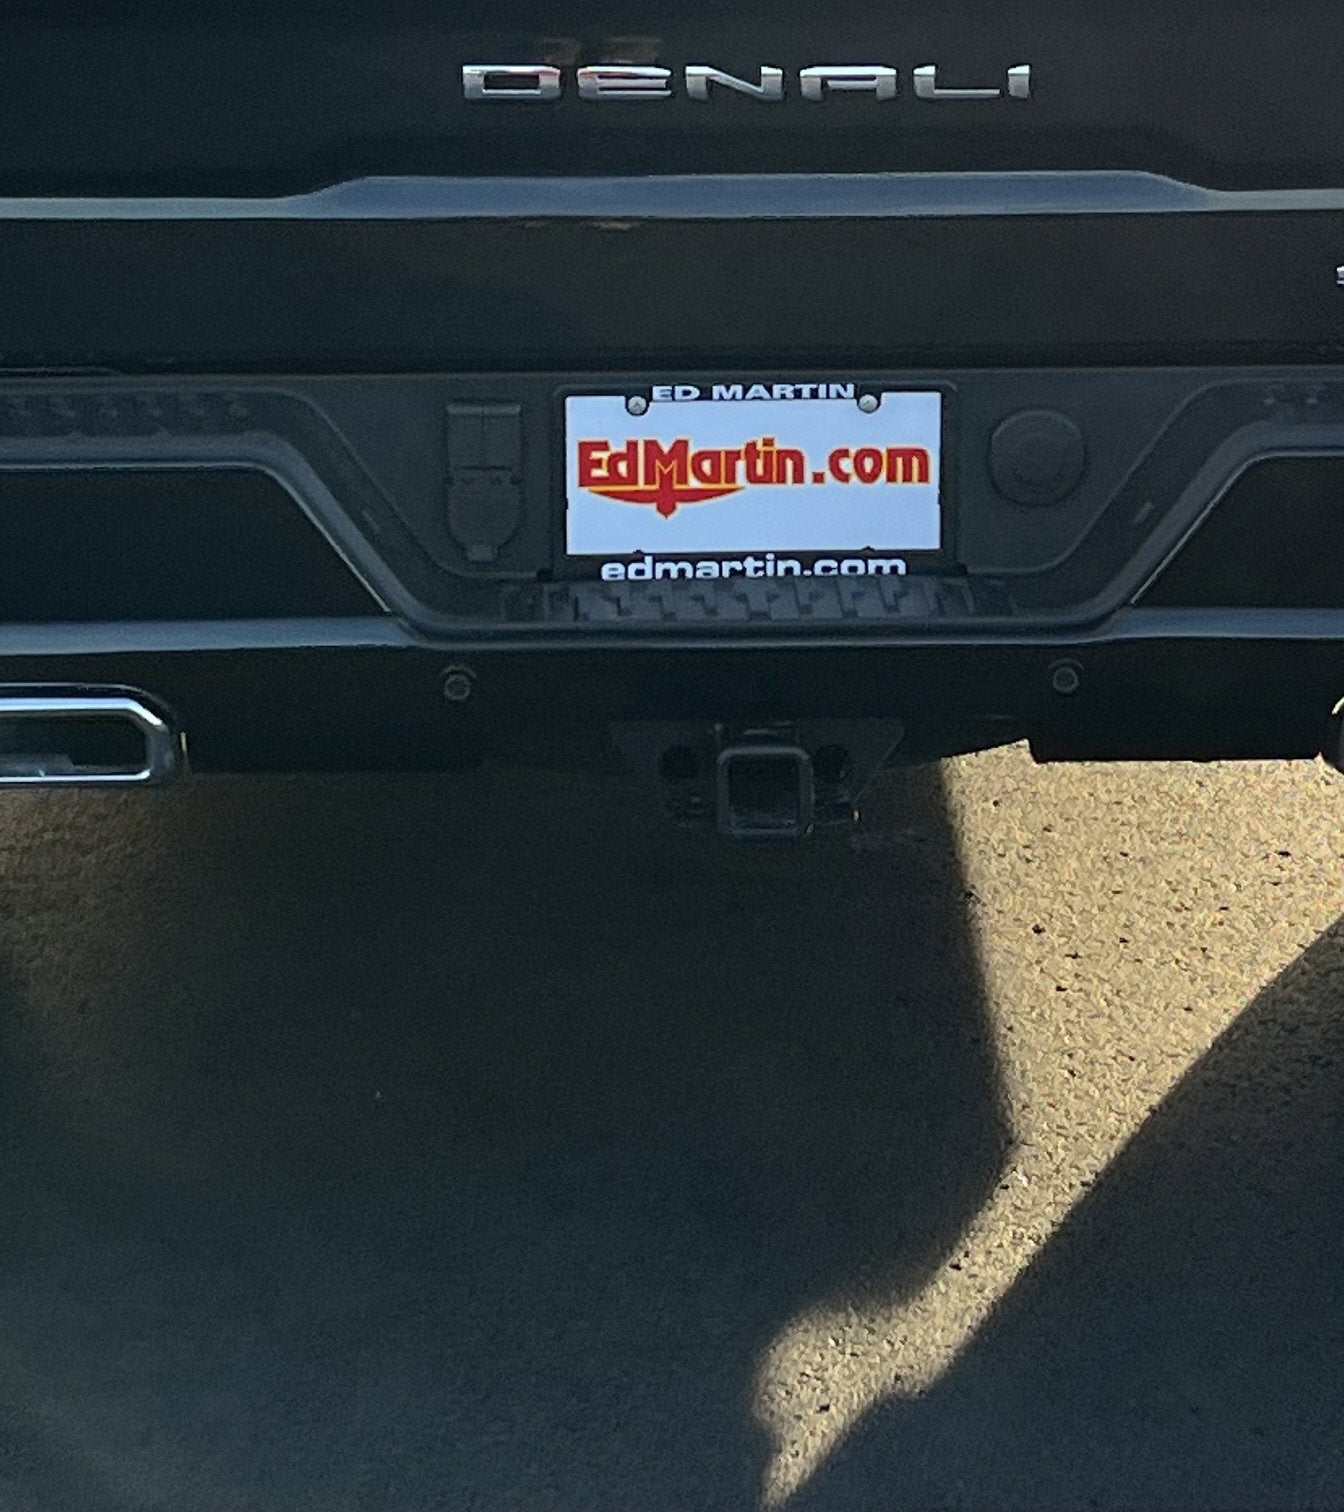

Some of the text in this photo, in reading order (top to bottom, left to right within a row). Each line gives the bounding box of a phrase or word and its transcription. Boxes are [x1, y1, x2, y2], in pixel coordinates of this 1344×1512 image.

[462, 64, 1031, 101] DENALI
[651, 382, 855, 402] ED MARTIN
[577, 437, 930, 488] EdMartin.com
[600, 553, 908, 582] edmartin.com
